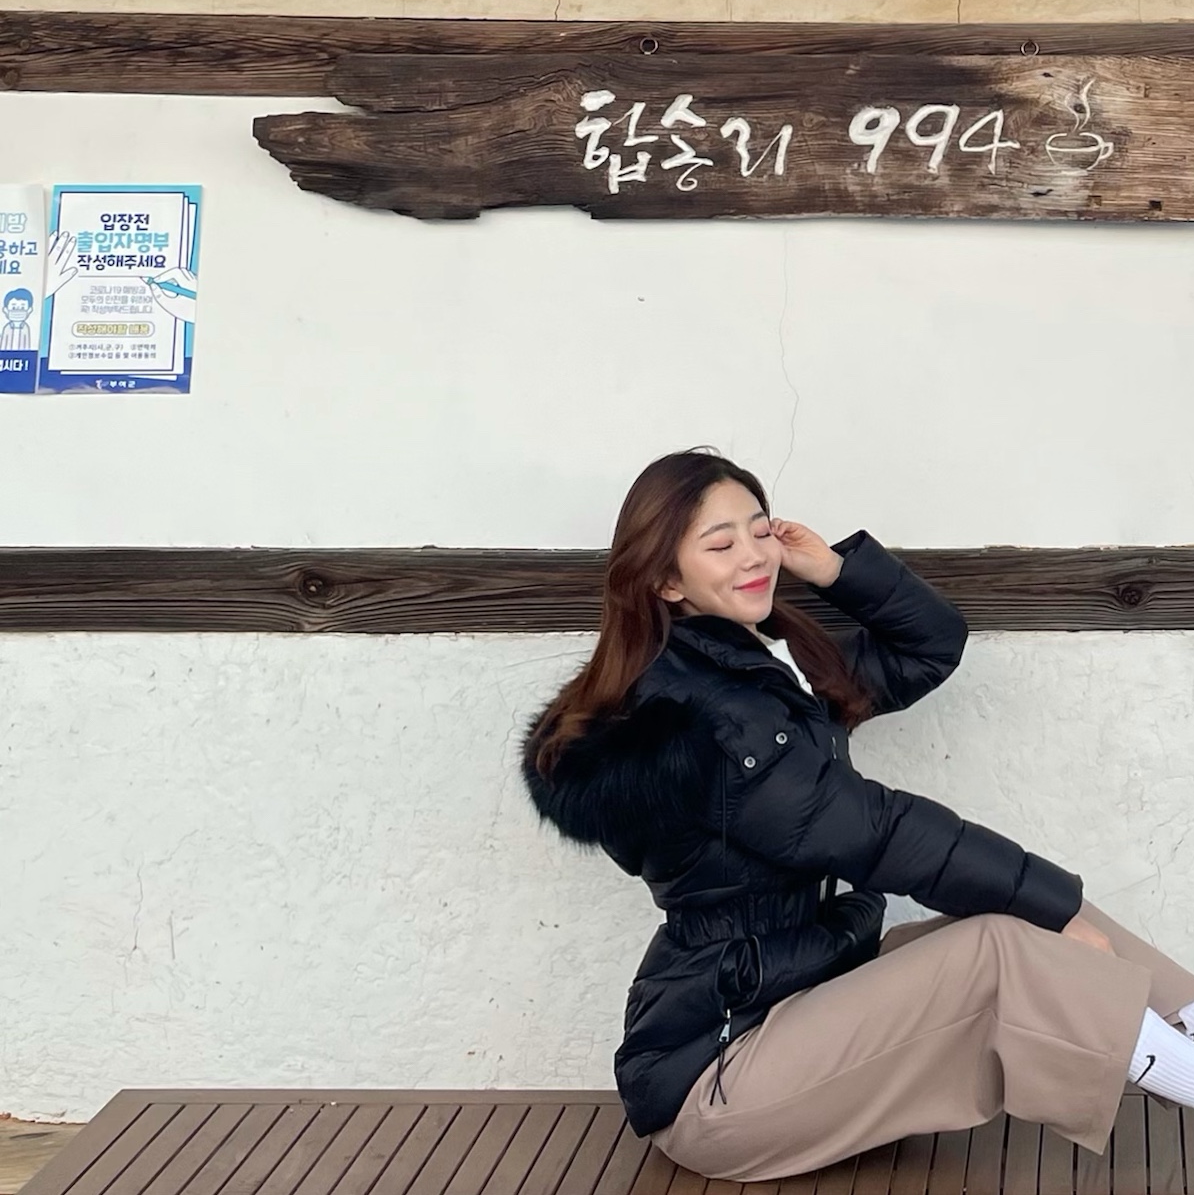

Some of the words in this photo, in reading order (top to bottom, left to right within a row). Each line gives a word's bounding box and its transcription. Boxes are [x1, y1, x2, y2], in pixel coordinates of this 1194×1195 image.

[575, 89, 793, 194] 합송리
[848, 105, 1020, 175] 994
[100, 213, 150, 231] 입장전
[77, 231, 169, 253] 출입자명부
[77, 254, 166, 271] 작성해주세요
